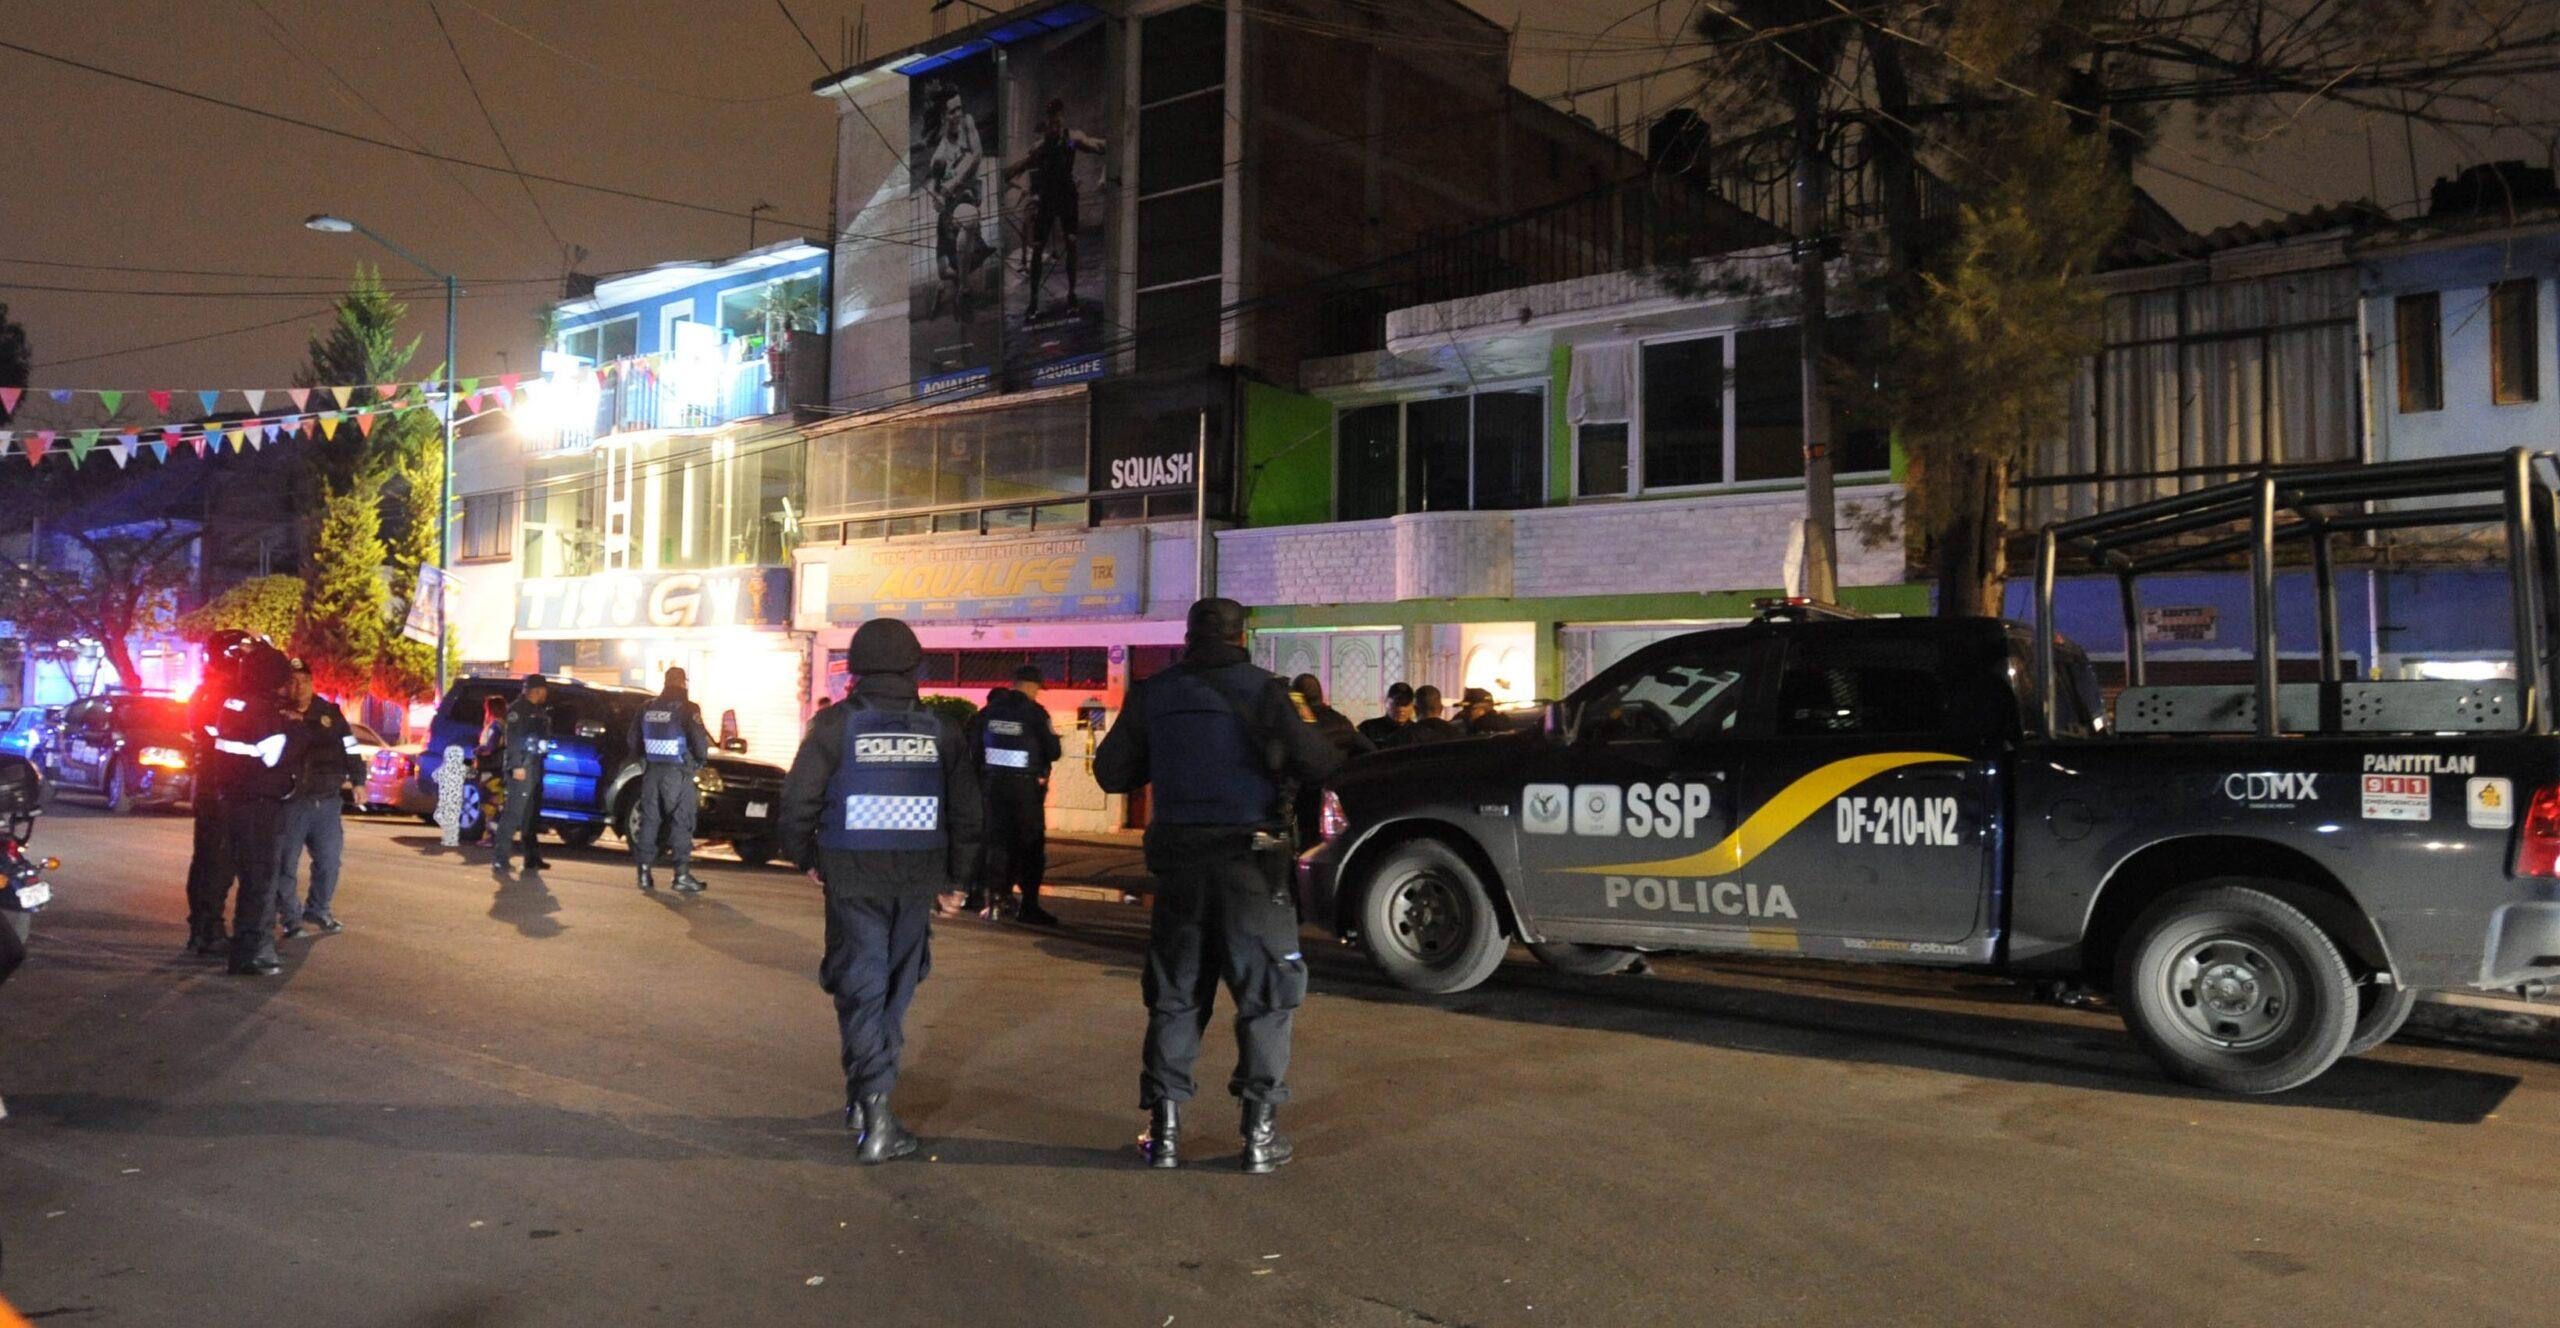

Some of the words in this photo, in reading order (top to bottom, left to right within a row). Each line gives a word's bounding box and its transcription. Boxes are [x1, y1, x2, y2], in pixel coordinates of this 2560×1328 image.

[1036, 358, 1101, 380] AQUALIFE
[1111, 452, 1193, 490] SQUASH
[1022, 539, 1088, 557] FUNCIONAL
[869, 555, 1077, 599] AQUALIFE
[1092, 564, 1114, 581] TRX
[855, 737, 940, 756] POLICÍA
[2363, 754, 2476, 774] PANTITLAN
[2225, 772, 2320, 801] CDMX
[2368, 778, 2424, 794] 911
[1626, 782, 1712, 838] SSP
[1837, 796, 1959, 846] DF-210-N2
[1605, 876, 1799, 919] POLICIA
